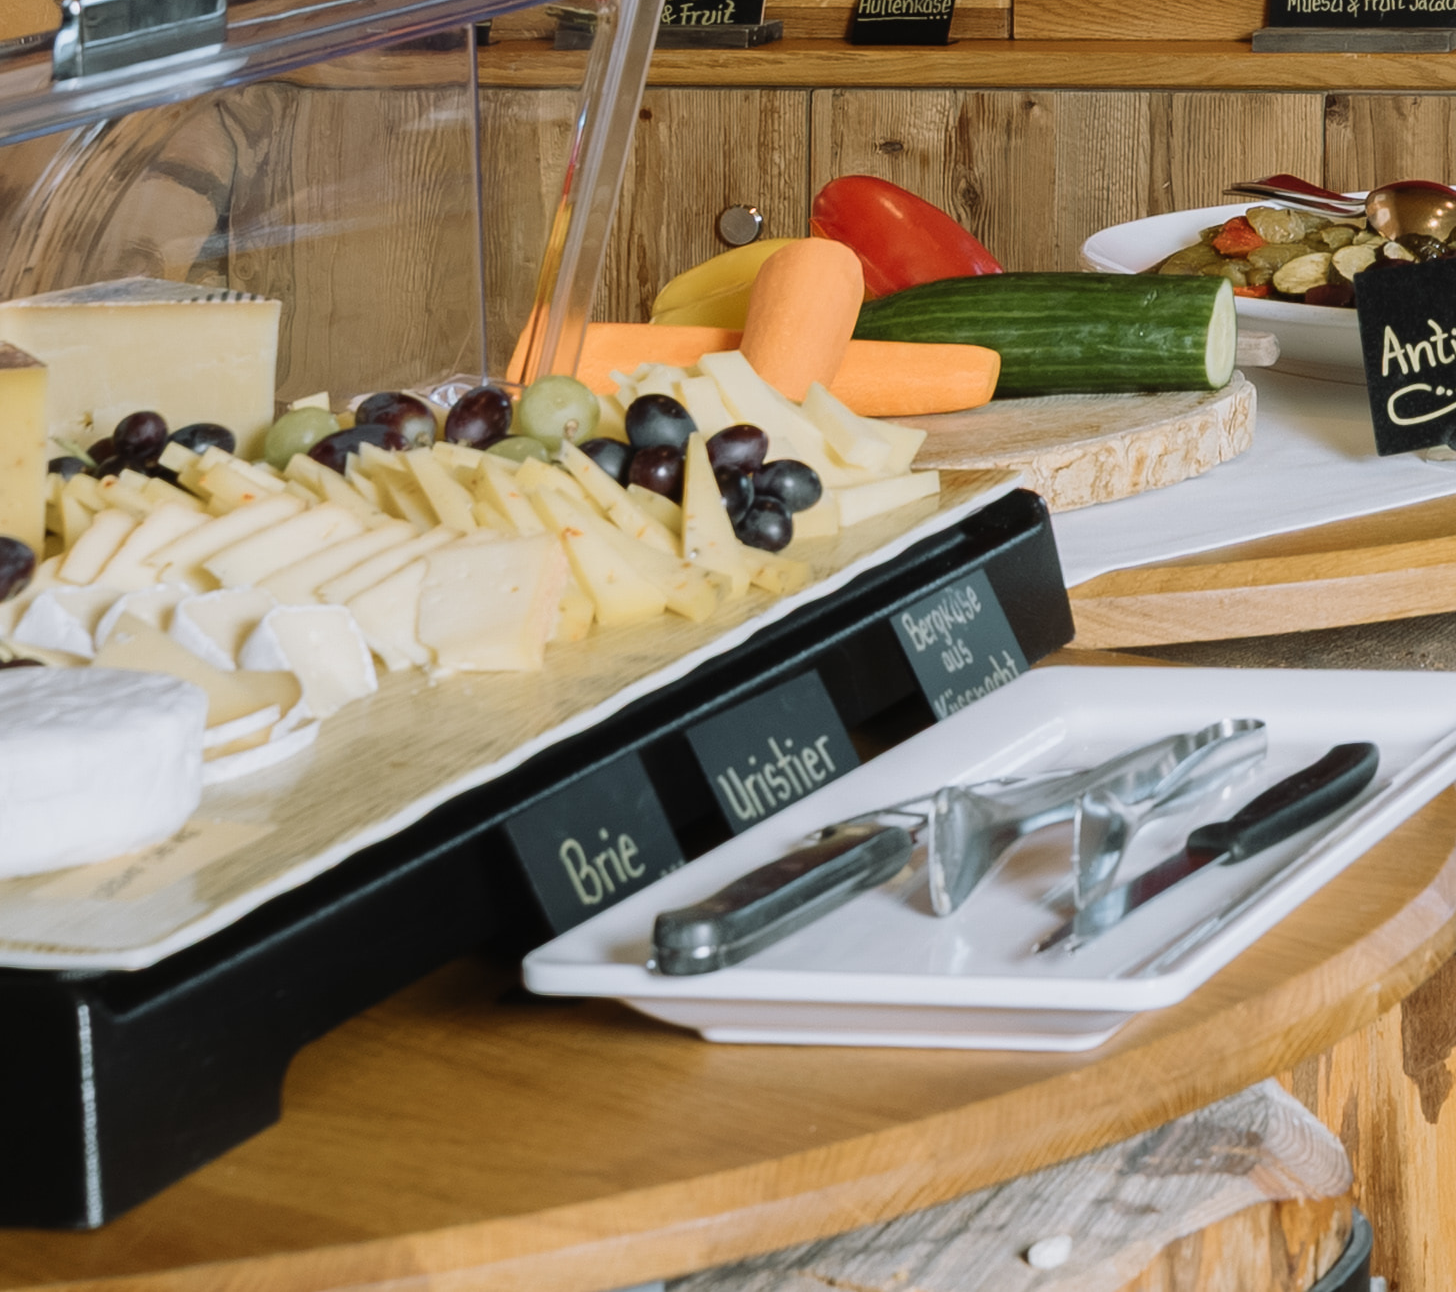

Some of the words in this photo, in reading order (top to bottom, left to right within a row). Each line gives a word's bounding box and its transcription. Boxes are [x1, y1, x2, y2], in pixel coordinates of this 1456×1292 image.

[680, 0, 737, 26] Fruit
[940, 638, 975, 674] aus
[556, 825, 648, 907] Brie
